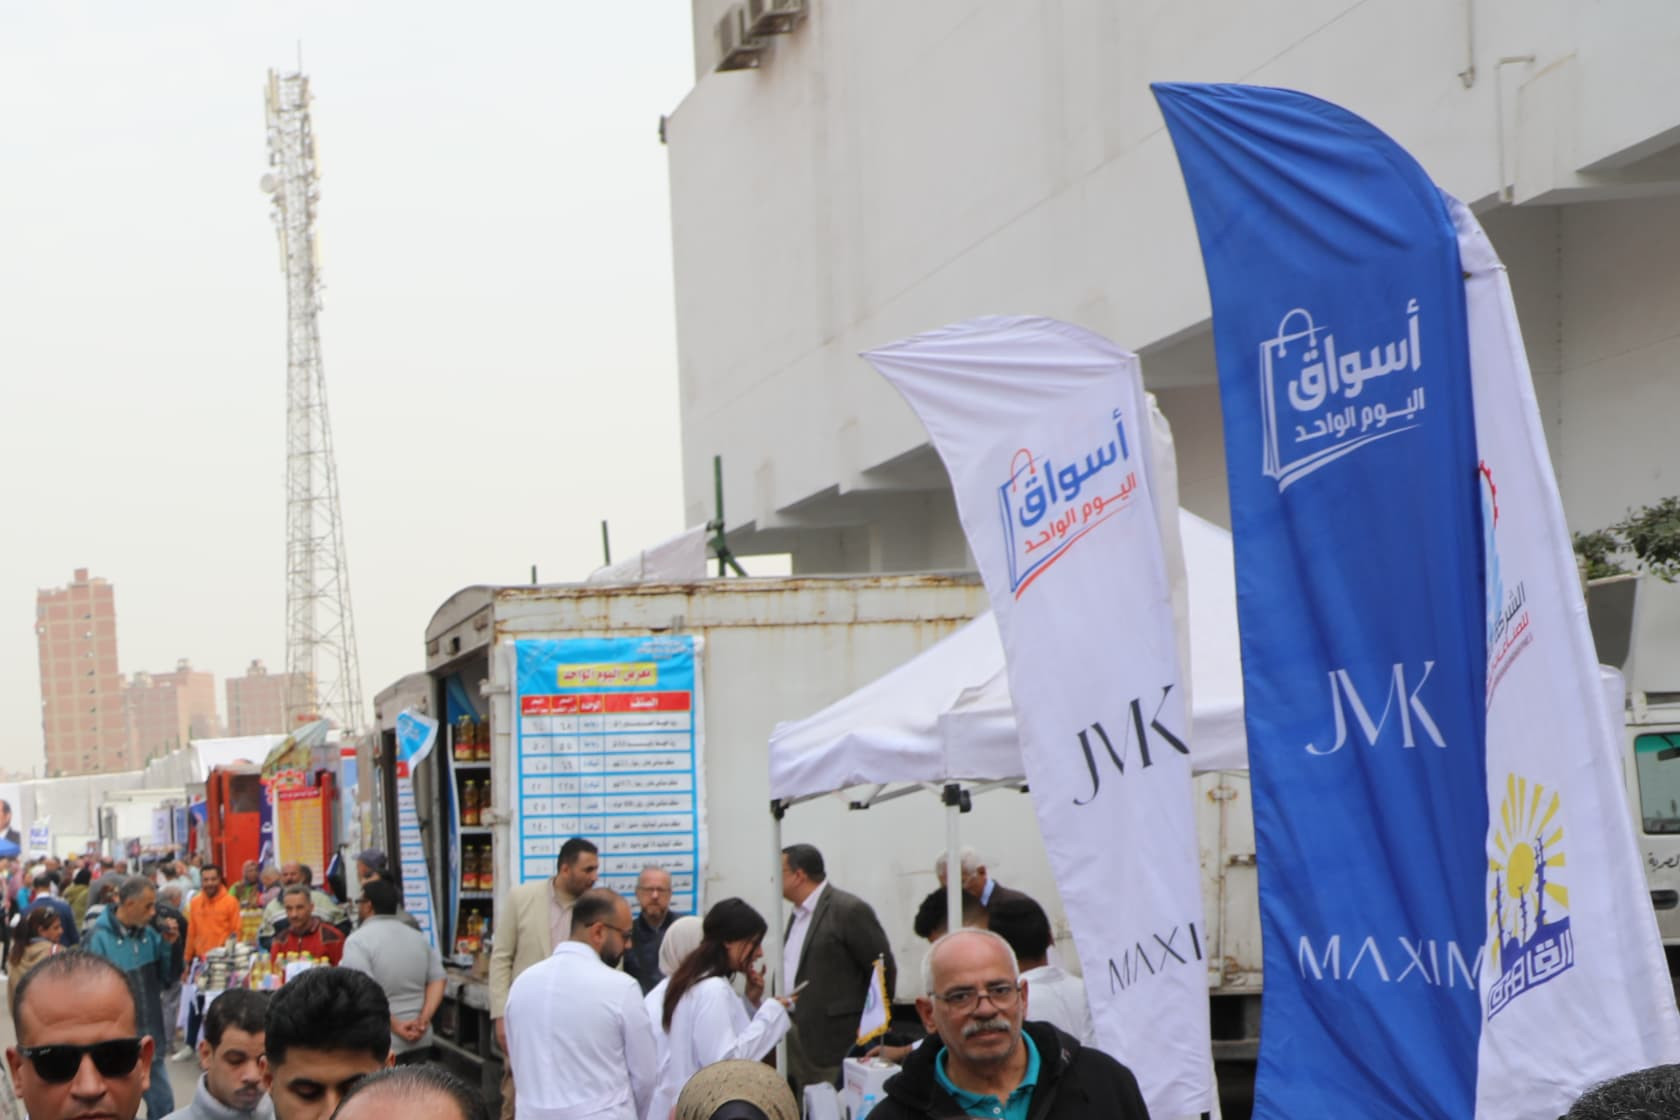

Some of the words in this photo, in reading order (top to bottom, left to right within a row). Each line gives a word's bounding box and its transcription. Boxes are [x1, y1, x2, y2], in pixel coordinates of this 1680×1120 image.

[1288, 298, 1421, 412] أسواق
[1295, 406, 1357, 443] الواحد
[1361, 387, 1425, 432] اليوم
[1019, 407, 1129, 528] أسواق
[1082, 472, 1137, 524] اليوم
[1025, 507, 1077, 553] الواحد
